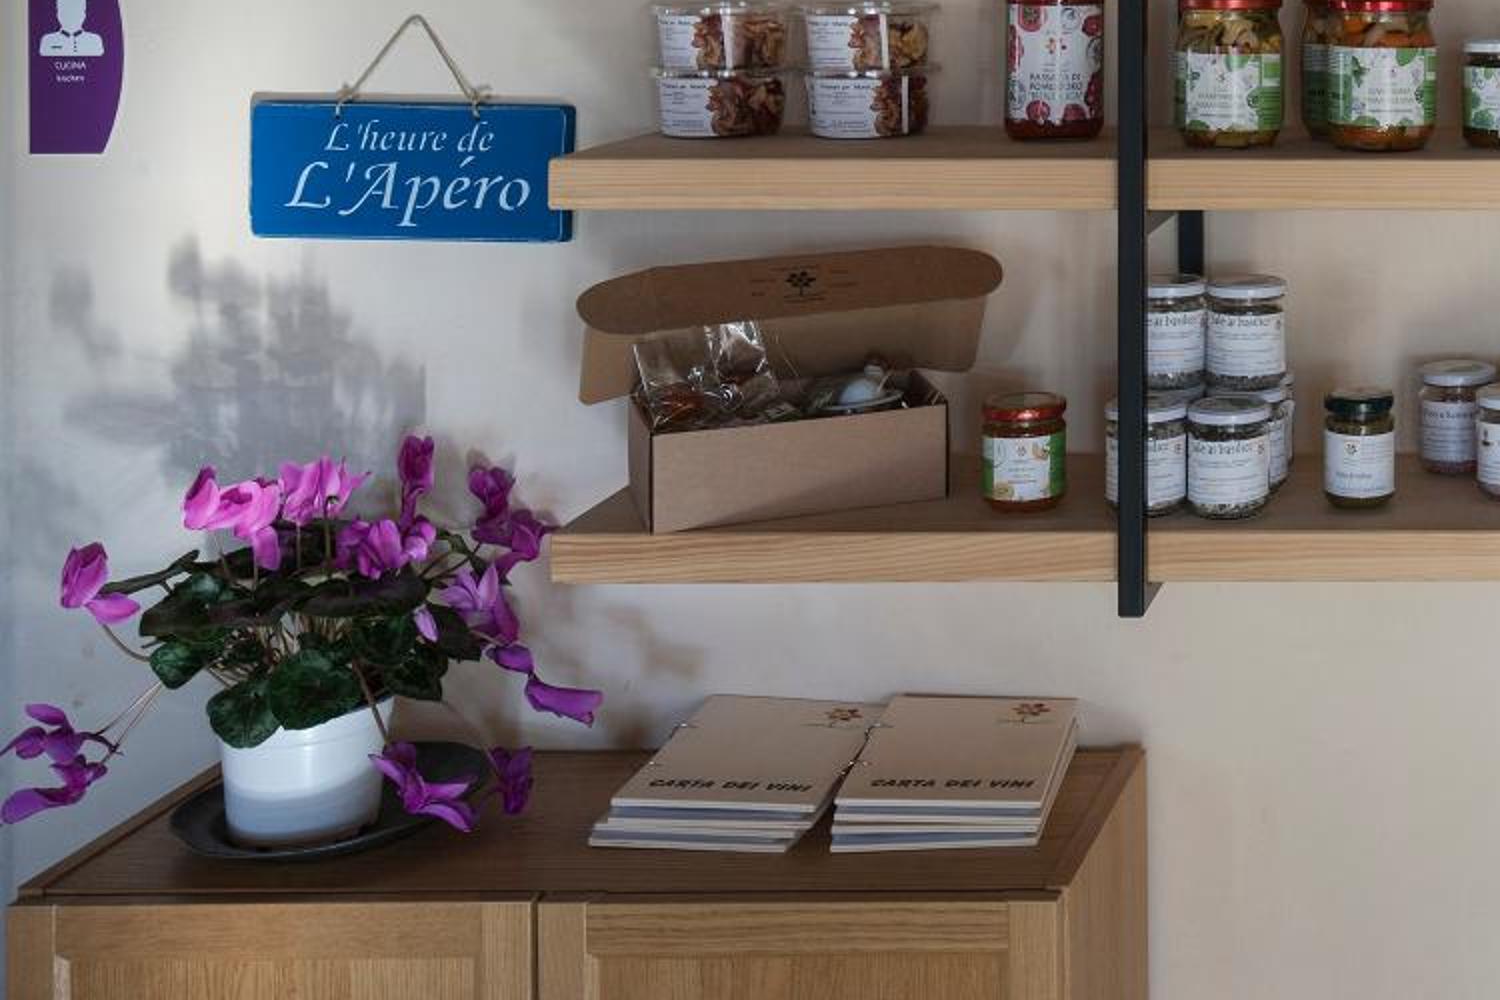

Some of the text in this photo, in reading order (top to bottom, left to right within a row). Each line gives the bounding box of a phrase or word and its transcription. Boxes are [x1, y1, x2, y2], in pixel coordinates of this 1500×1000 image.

[55, 61, 86, 71] CUCINA
[325, 119, 494, 152] L'heure de
[285, 156, 530, 228] L'Apéro
[649, 779, 813, 793] CARTA DEI VINI
[871, 778, 1035, 789] CARTA DEI VINI
